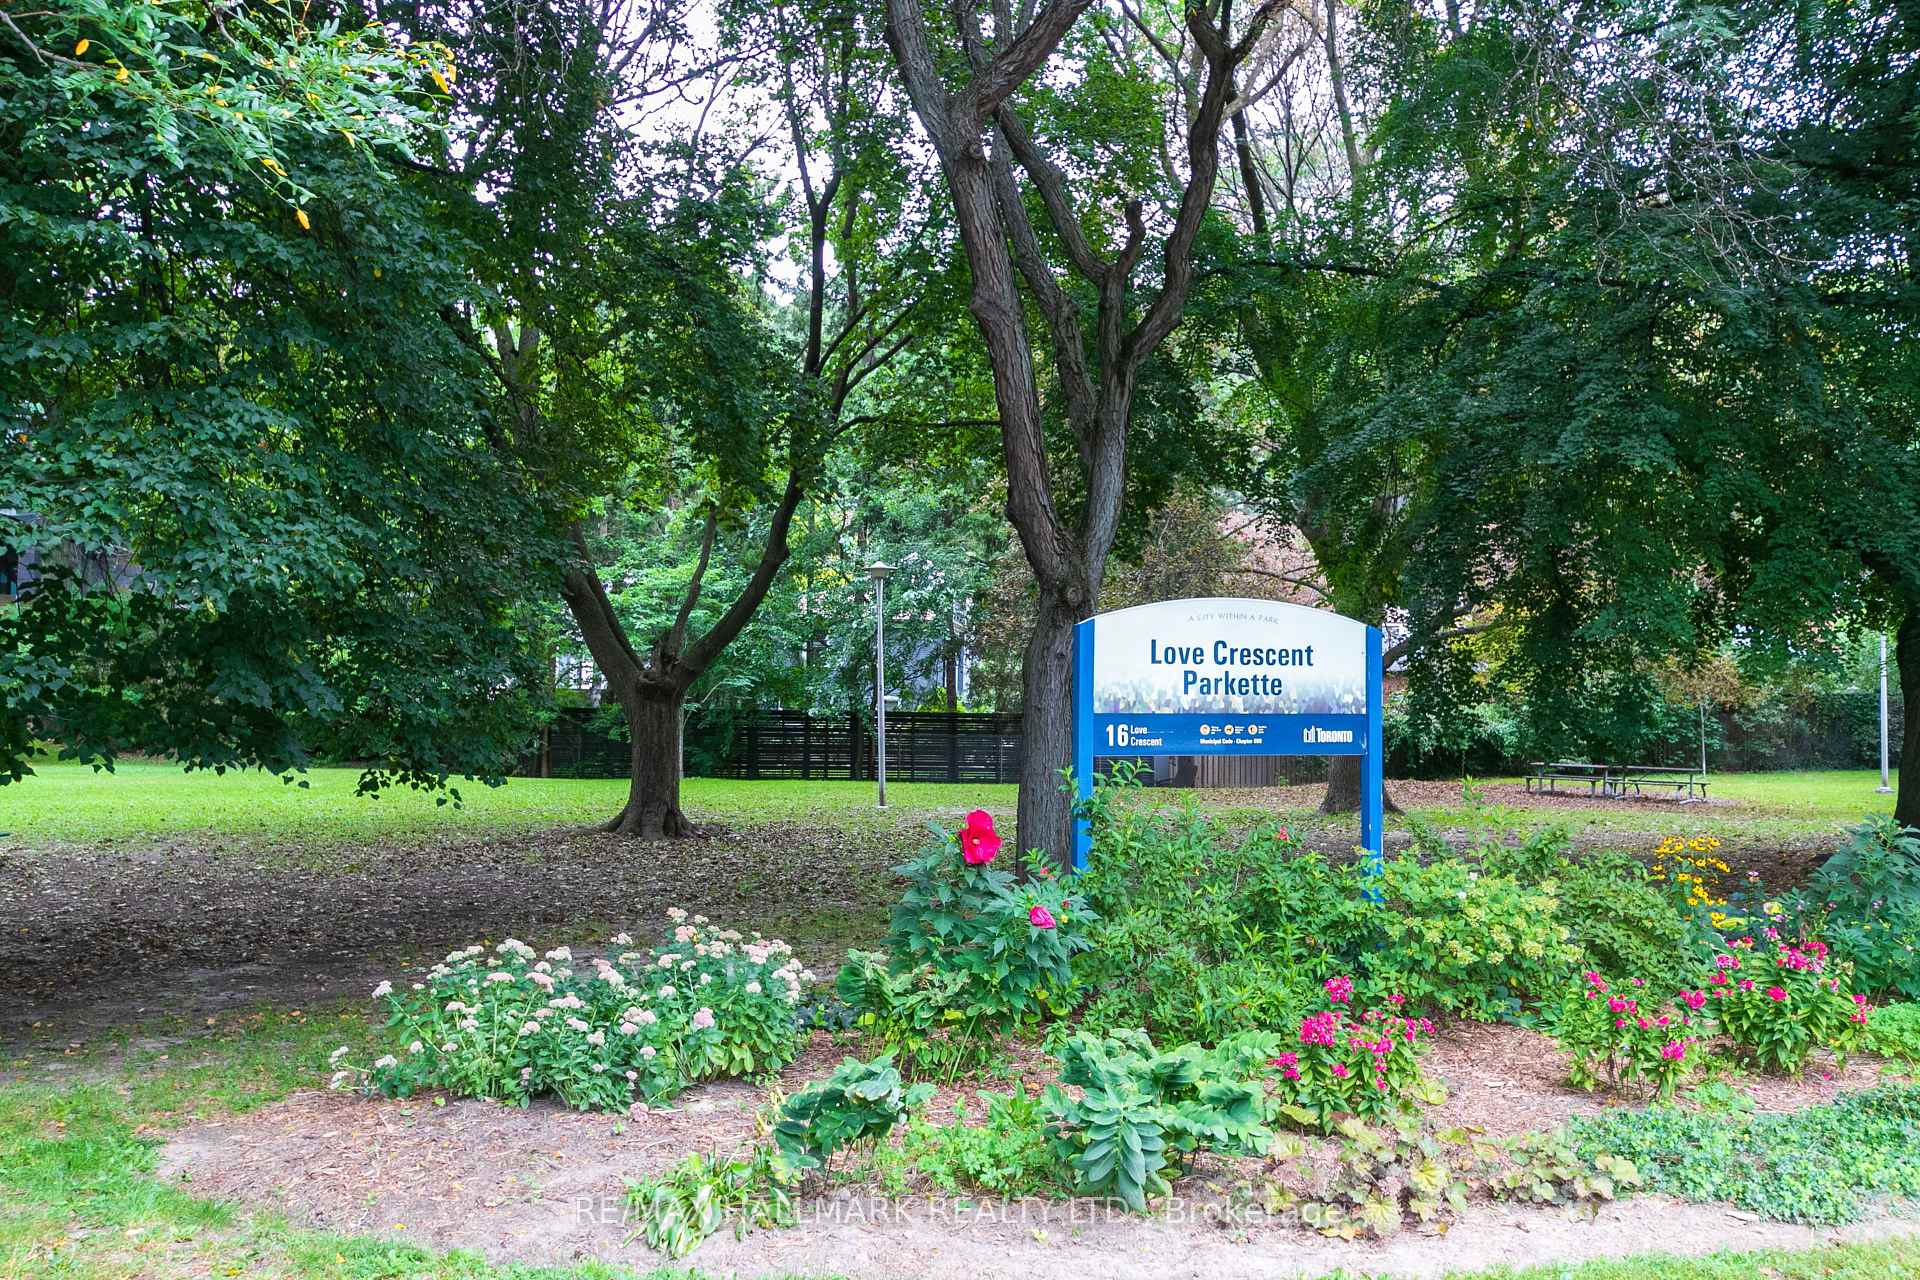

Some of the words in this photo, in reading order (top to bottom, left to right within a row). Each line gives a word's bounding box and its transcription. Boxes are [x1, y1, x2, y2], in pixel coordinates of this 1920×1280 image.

[1150, 638, 1205, 666] Love
[1213, 639, 1314, 667] Crescent
[1183, 669, 1283, 696] Parkette
[1106, 723, 1129, 747] 16
[1130, 725, 1148, 734] Love
[1316, 727, 1353, 743] TORONTO
[1130, 736, 1162, 746] Crescent
